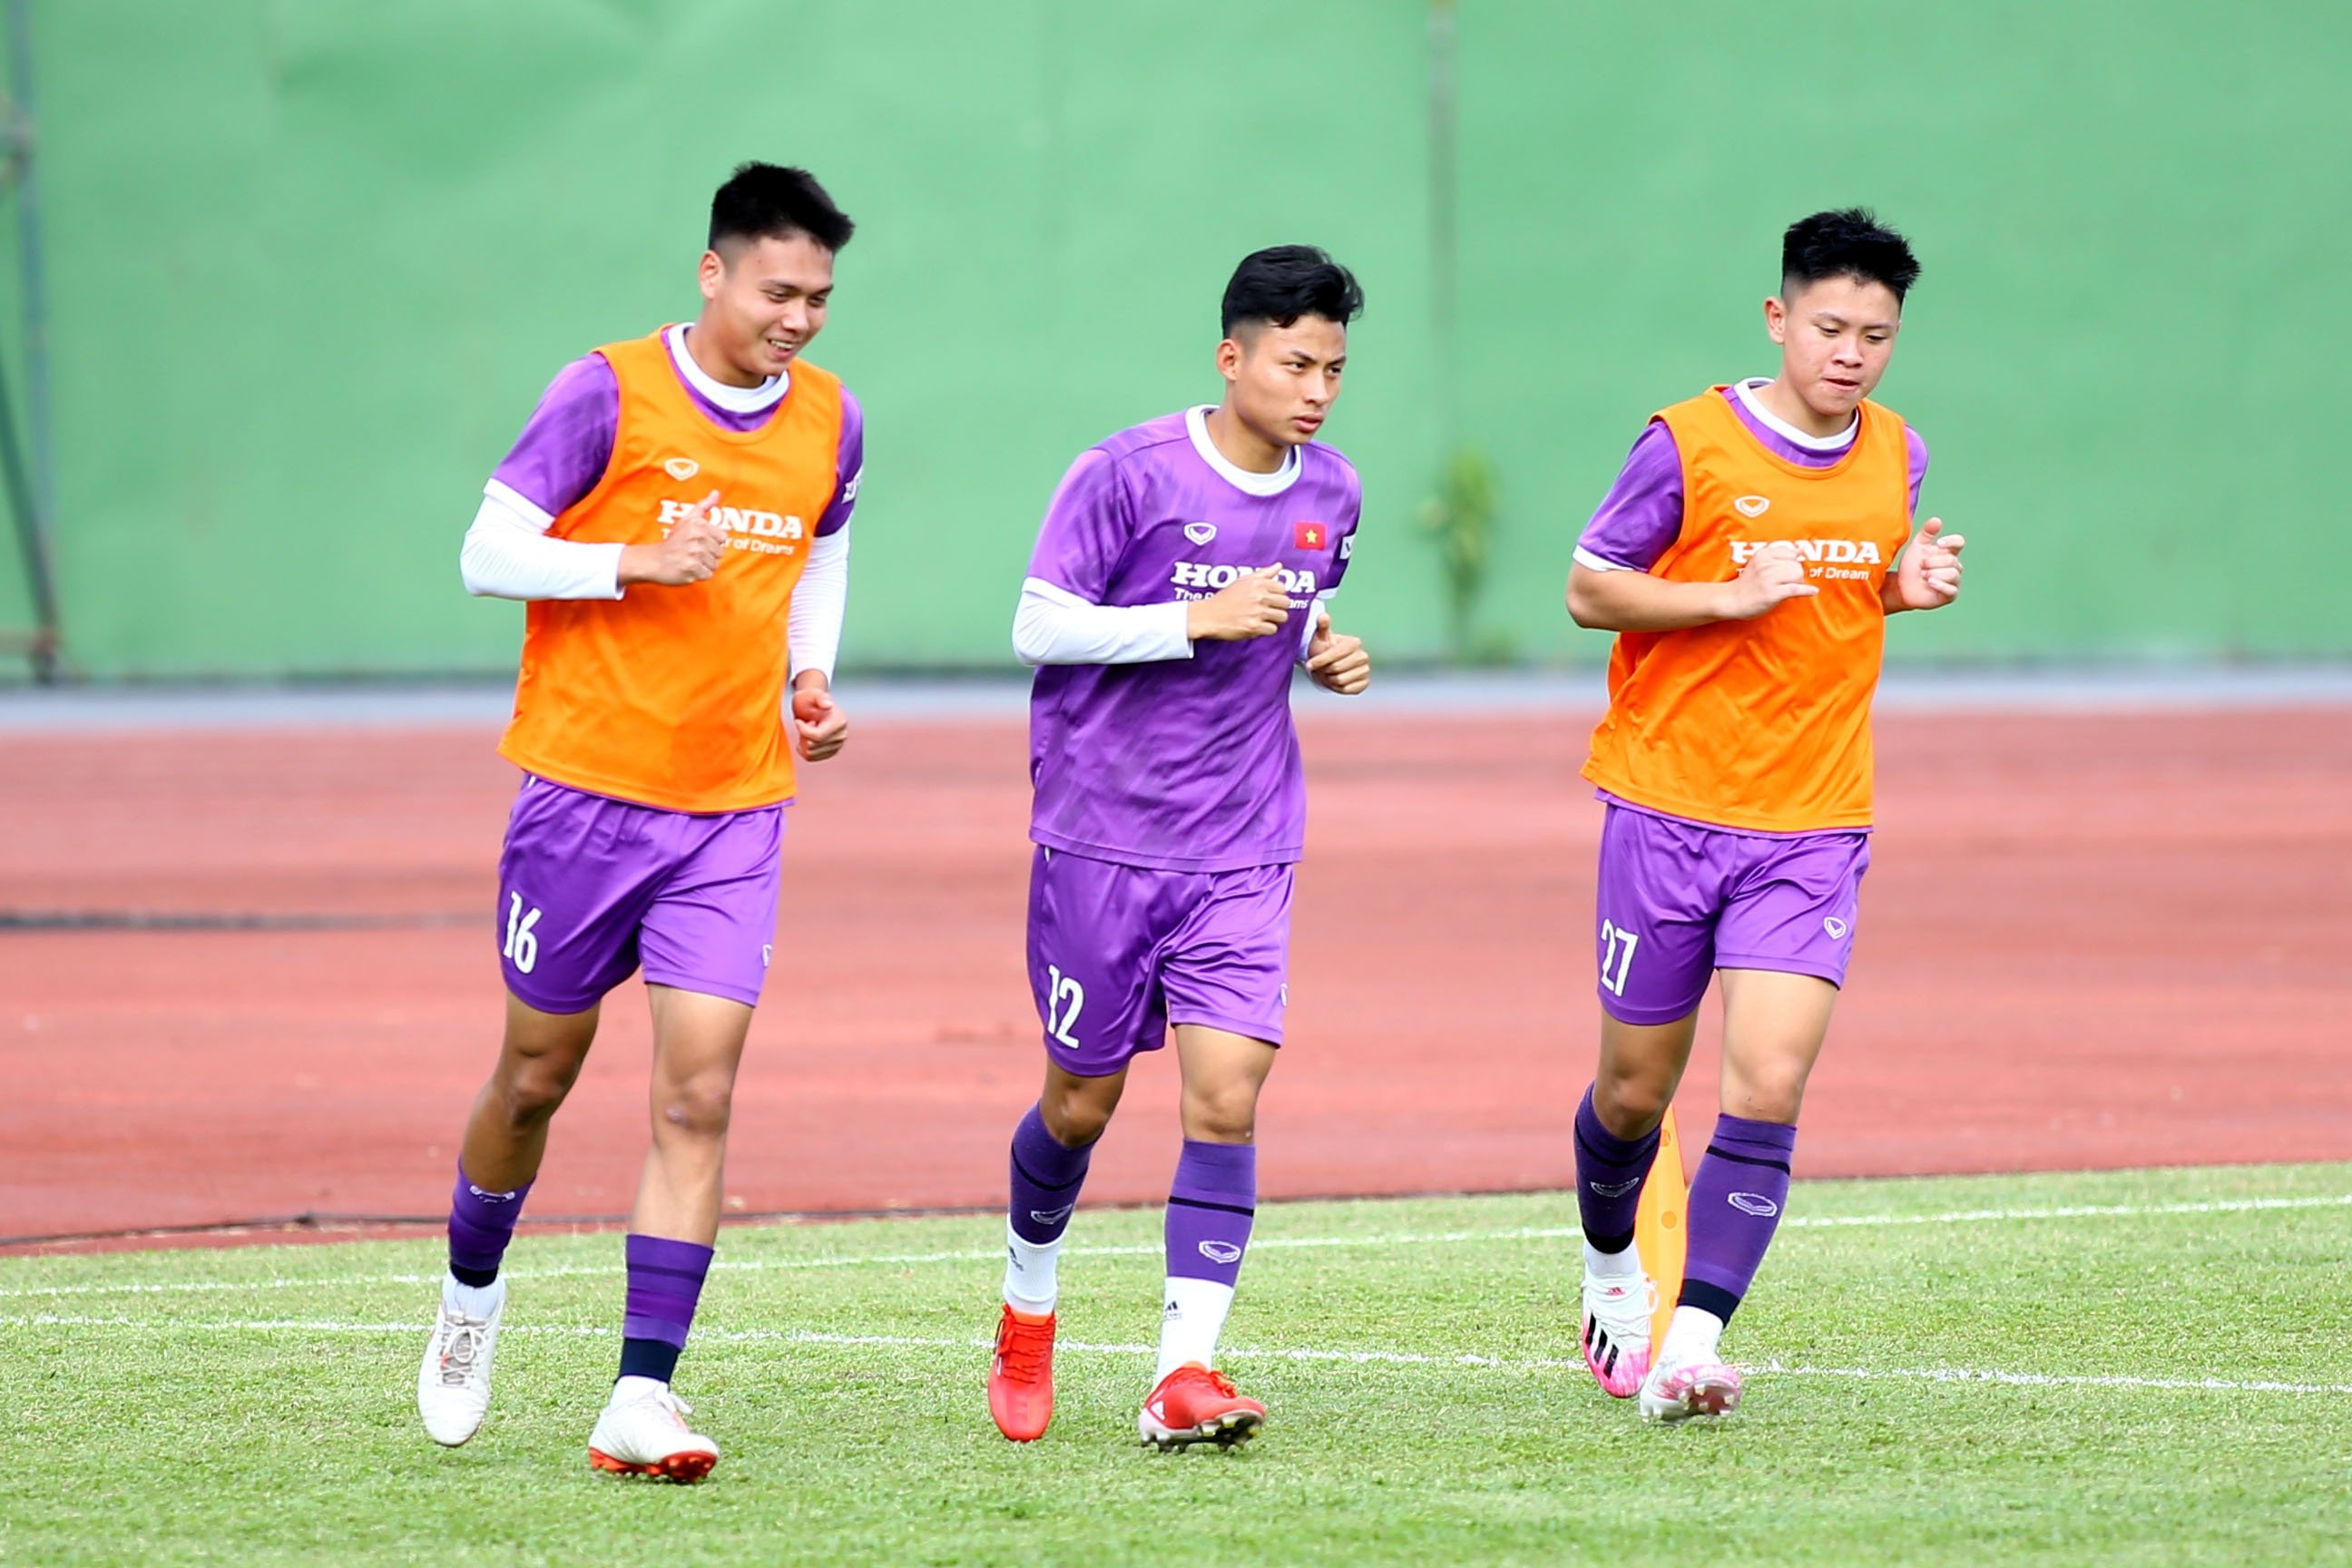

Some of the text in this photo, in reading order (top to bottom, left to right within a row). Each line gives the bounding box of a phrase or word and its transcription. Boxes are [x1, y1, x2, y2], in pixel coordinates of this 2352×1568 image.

[733, 537, 750, 551] of
[1730, 539, 1881, 564] HNDA
[1174, 587, 1202, 600] The
[504, 890, 543, 974] 16
[1601, 918, 1639, 997] 27
[1047, 965, 1084, 1048] 12
